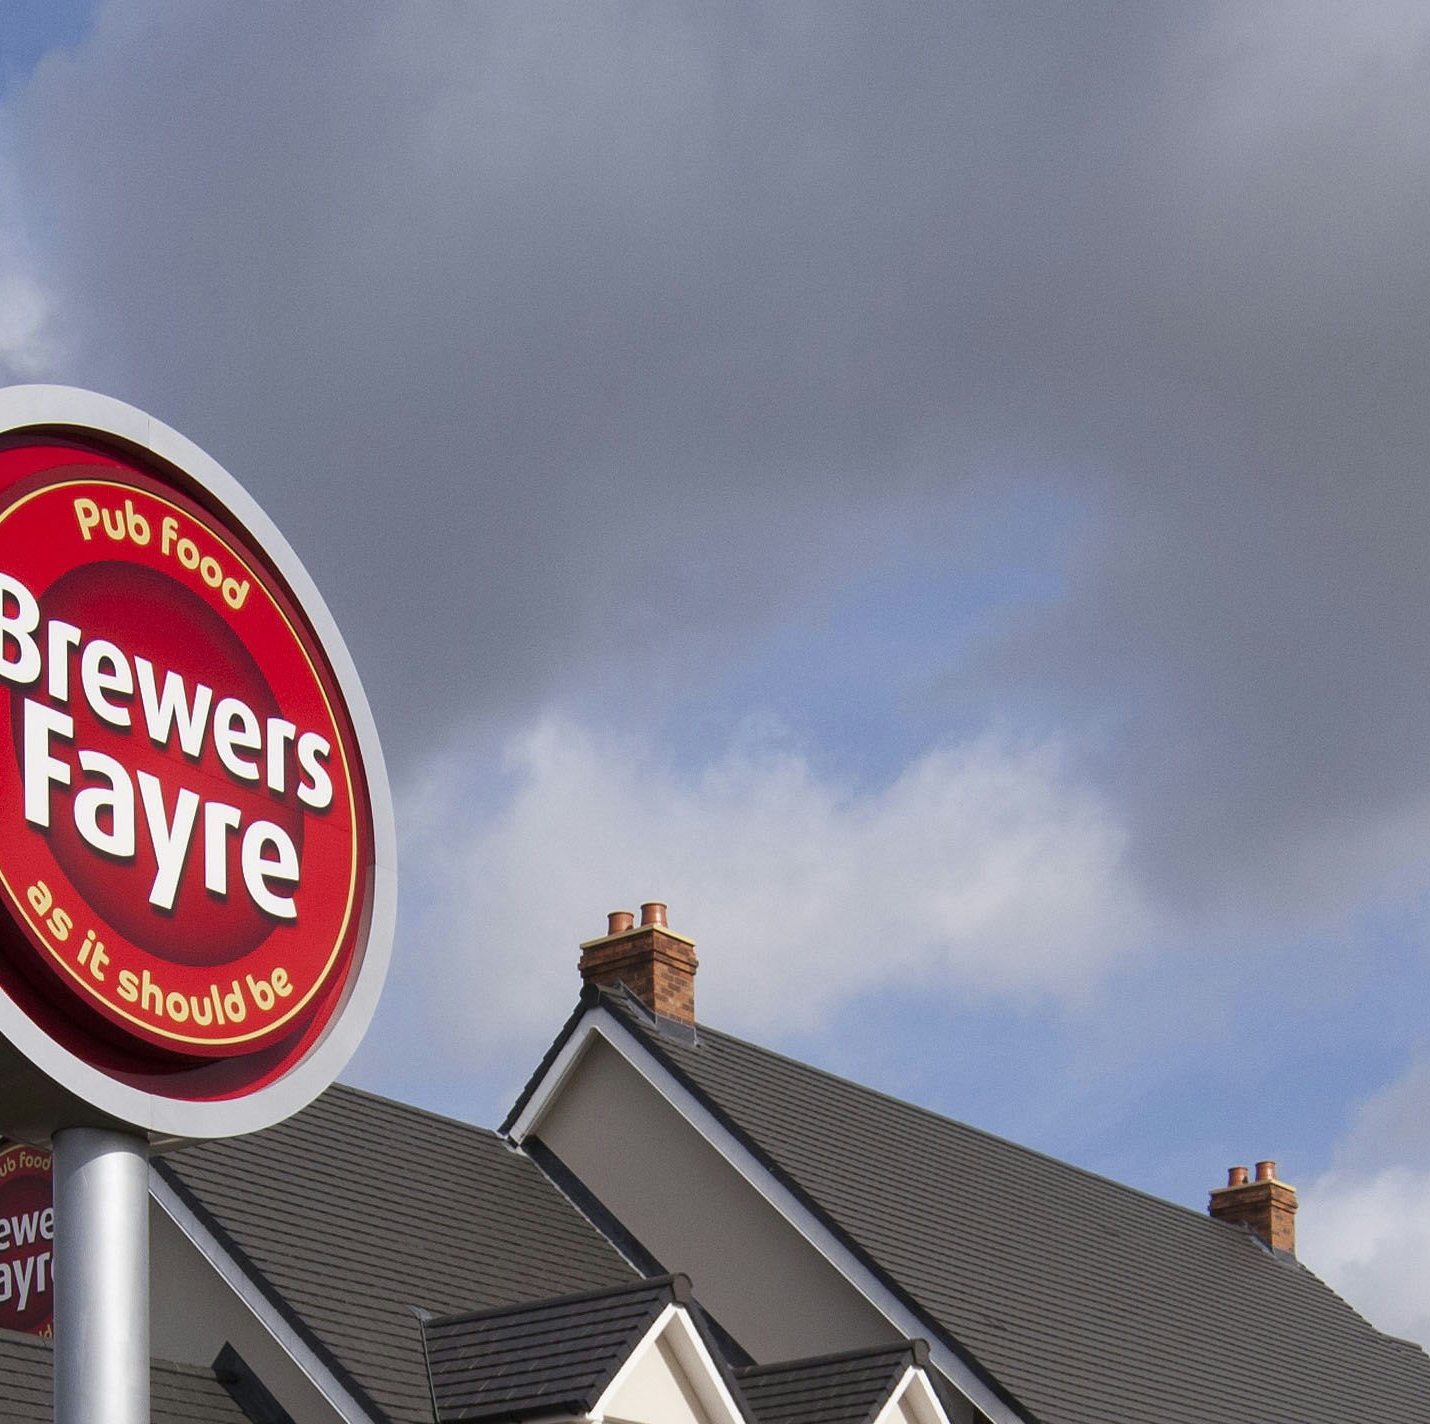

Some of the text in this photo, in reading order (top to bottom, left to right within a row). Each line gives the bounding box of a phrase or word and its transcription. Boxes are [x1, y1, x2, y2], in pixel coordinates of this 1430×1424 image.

[74, 498, 250, 610] Pub food
[24, 698, 299, 919] Fayre
[27, 880, 293, 1025] as it should be
[19, 1151, 52, 1171] food
